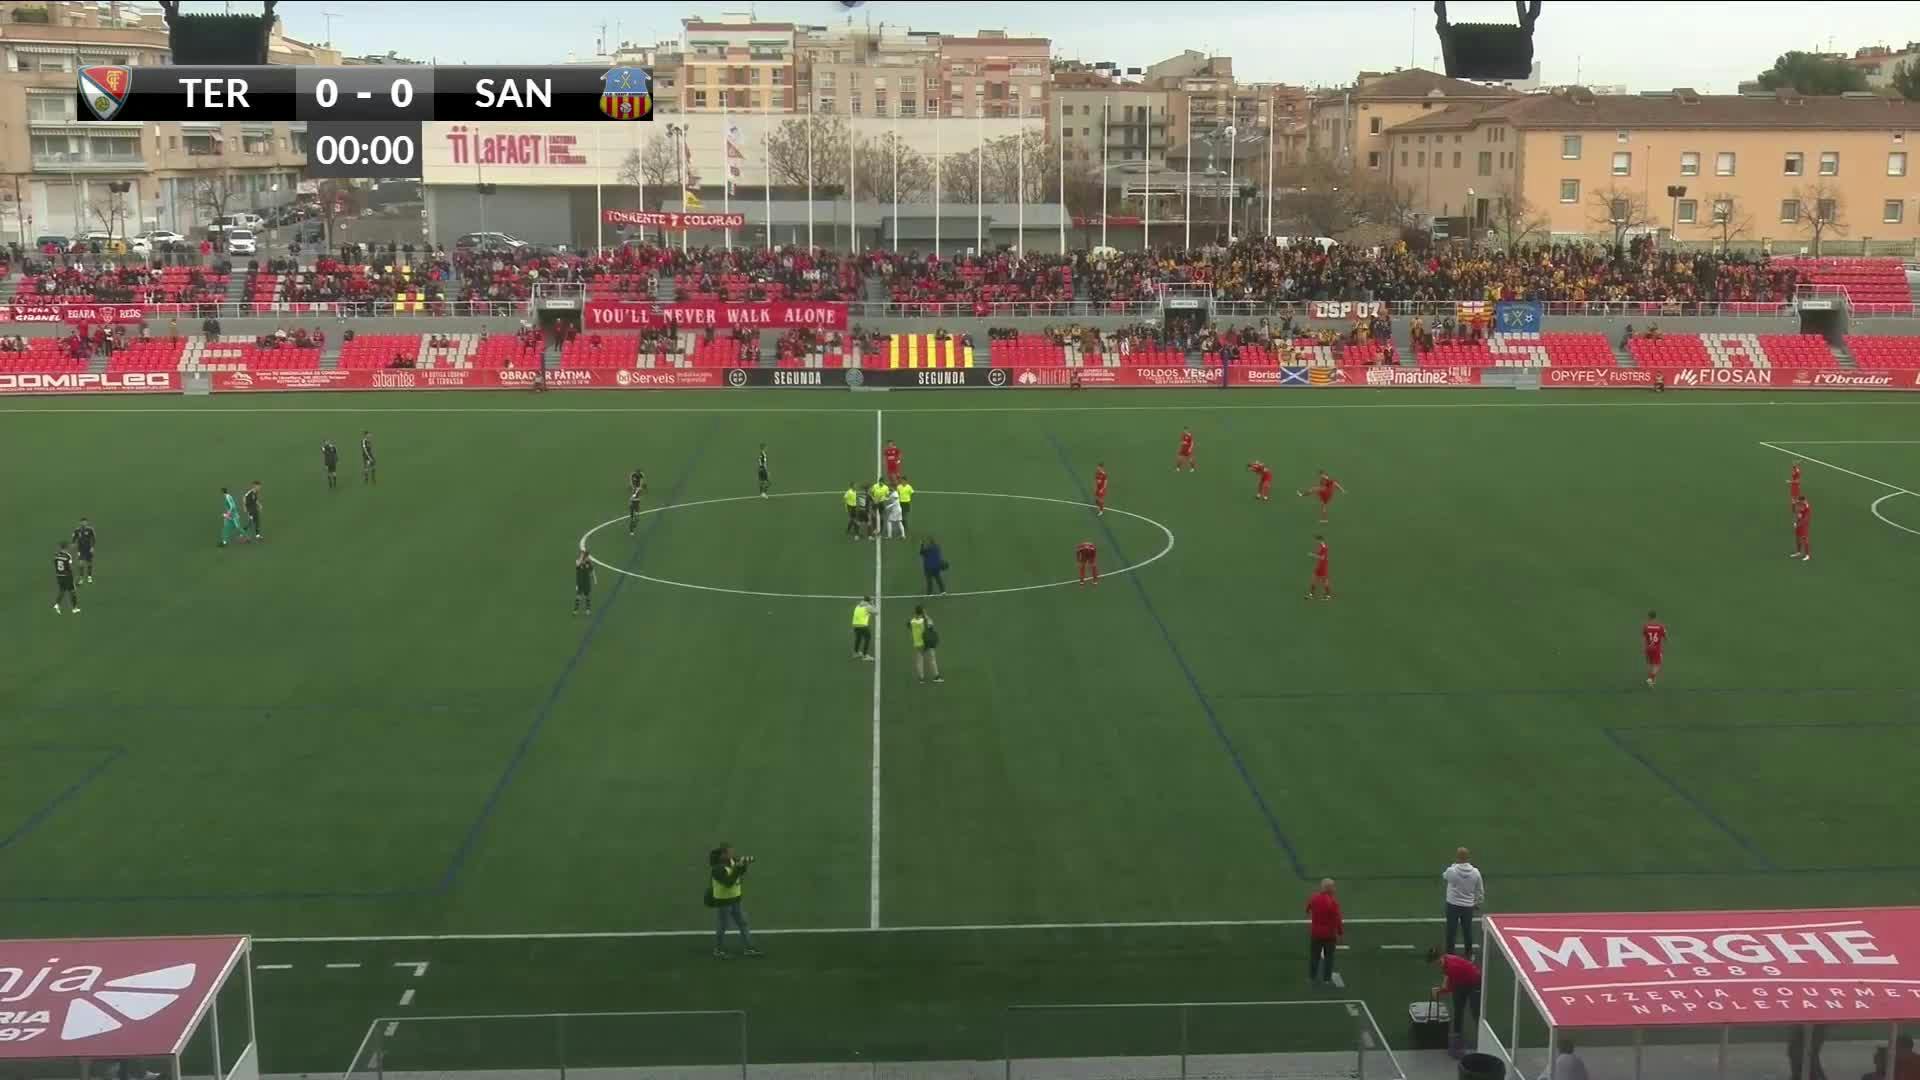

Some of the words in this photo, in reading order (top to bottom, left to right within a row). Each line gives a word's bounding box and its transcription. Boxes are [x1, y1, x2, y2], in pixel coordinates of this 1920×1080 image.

[473, 134, 542, 164] LaFACT
[607, 210, 667, 224] TORRENTE
[67, 309, 96, 319] EGARA
[119, 309, 142, 319] REDS
[593, 308, 650, 323] YOU'LL
[663, 308, 716, 323] NEVER
[727, 308, 771, 323] WALK
[784, 308, 836, 324] ALONE
[1316, 302, 1352, 318] DSP
[1357, 302, 1380, 318] 07
[499, 371, 552, 380] OBRADR
[632, 371, 676, 384] Serveis
[774, 371, 821, 385] SEGUNDA
[918, 371, 965, 385] SEGUNDA
[1136, 368, 1179, 377] TOLDOS
[1610, 371, 1651, 382] FUSTERS
[1700, 369, 1771, 383] FIOSAN
[1512, 929, 1899, 973] MARGHE
[1665, 965, 1783, 979] 1889
[1561, 987, 1729, 1006] PIZZERIA
[1631, 1000, 1871, 1016] NAPOLETANA
